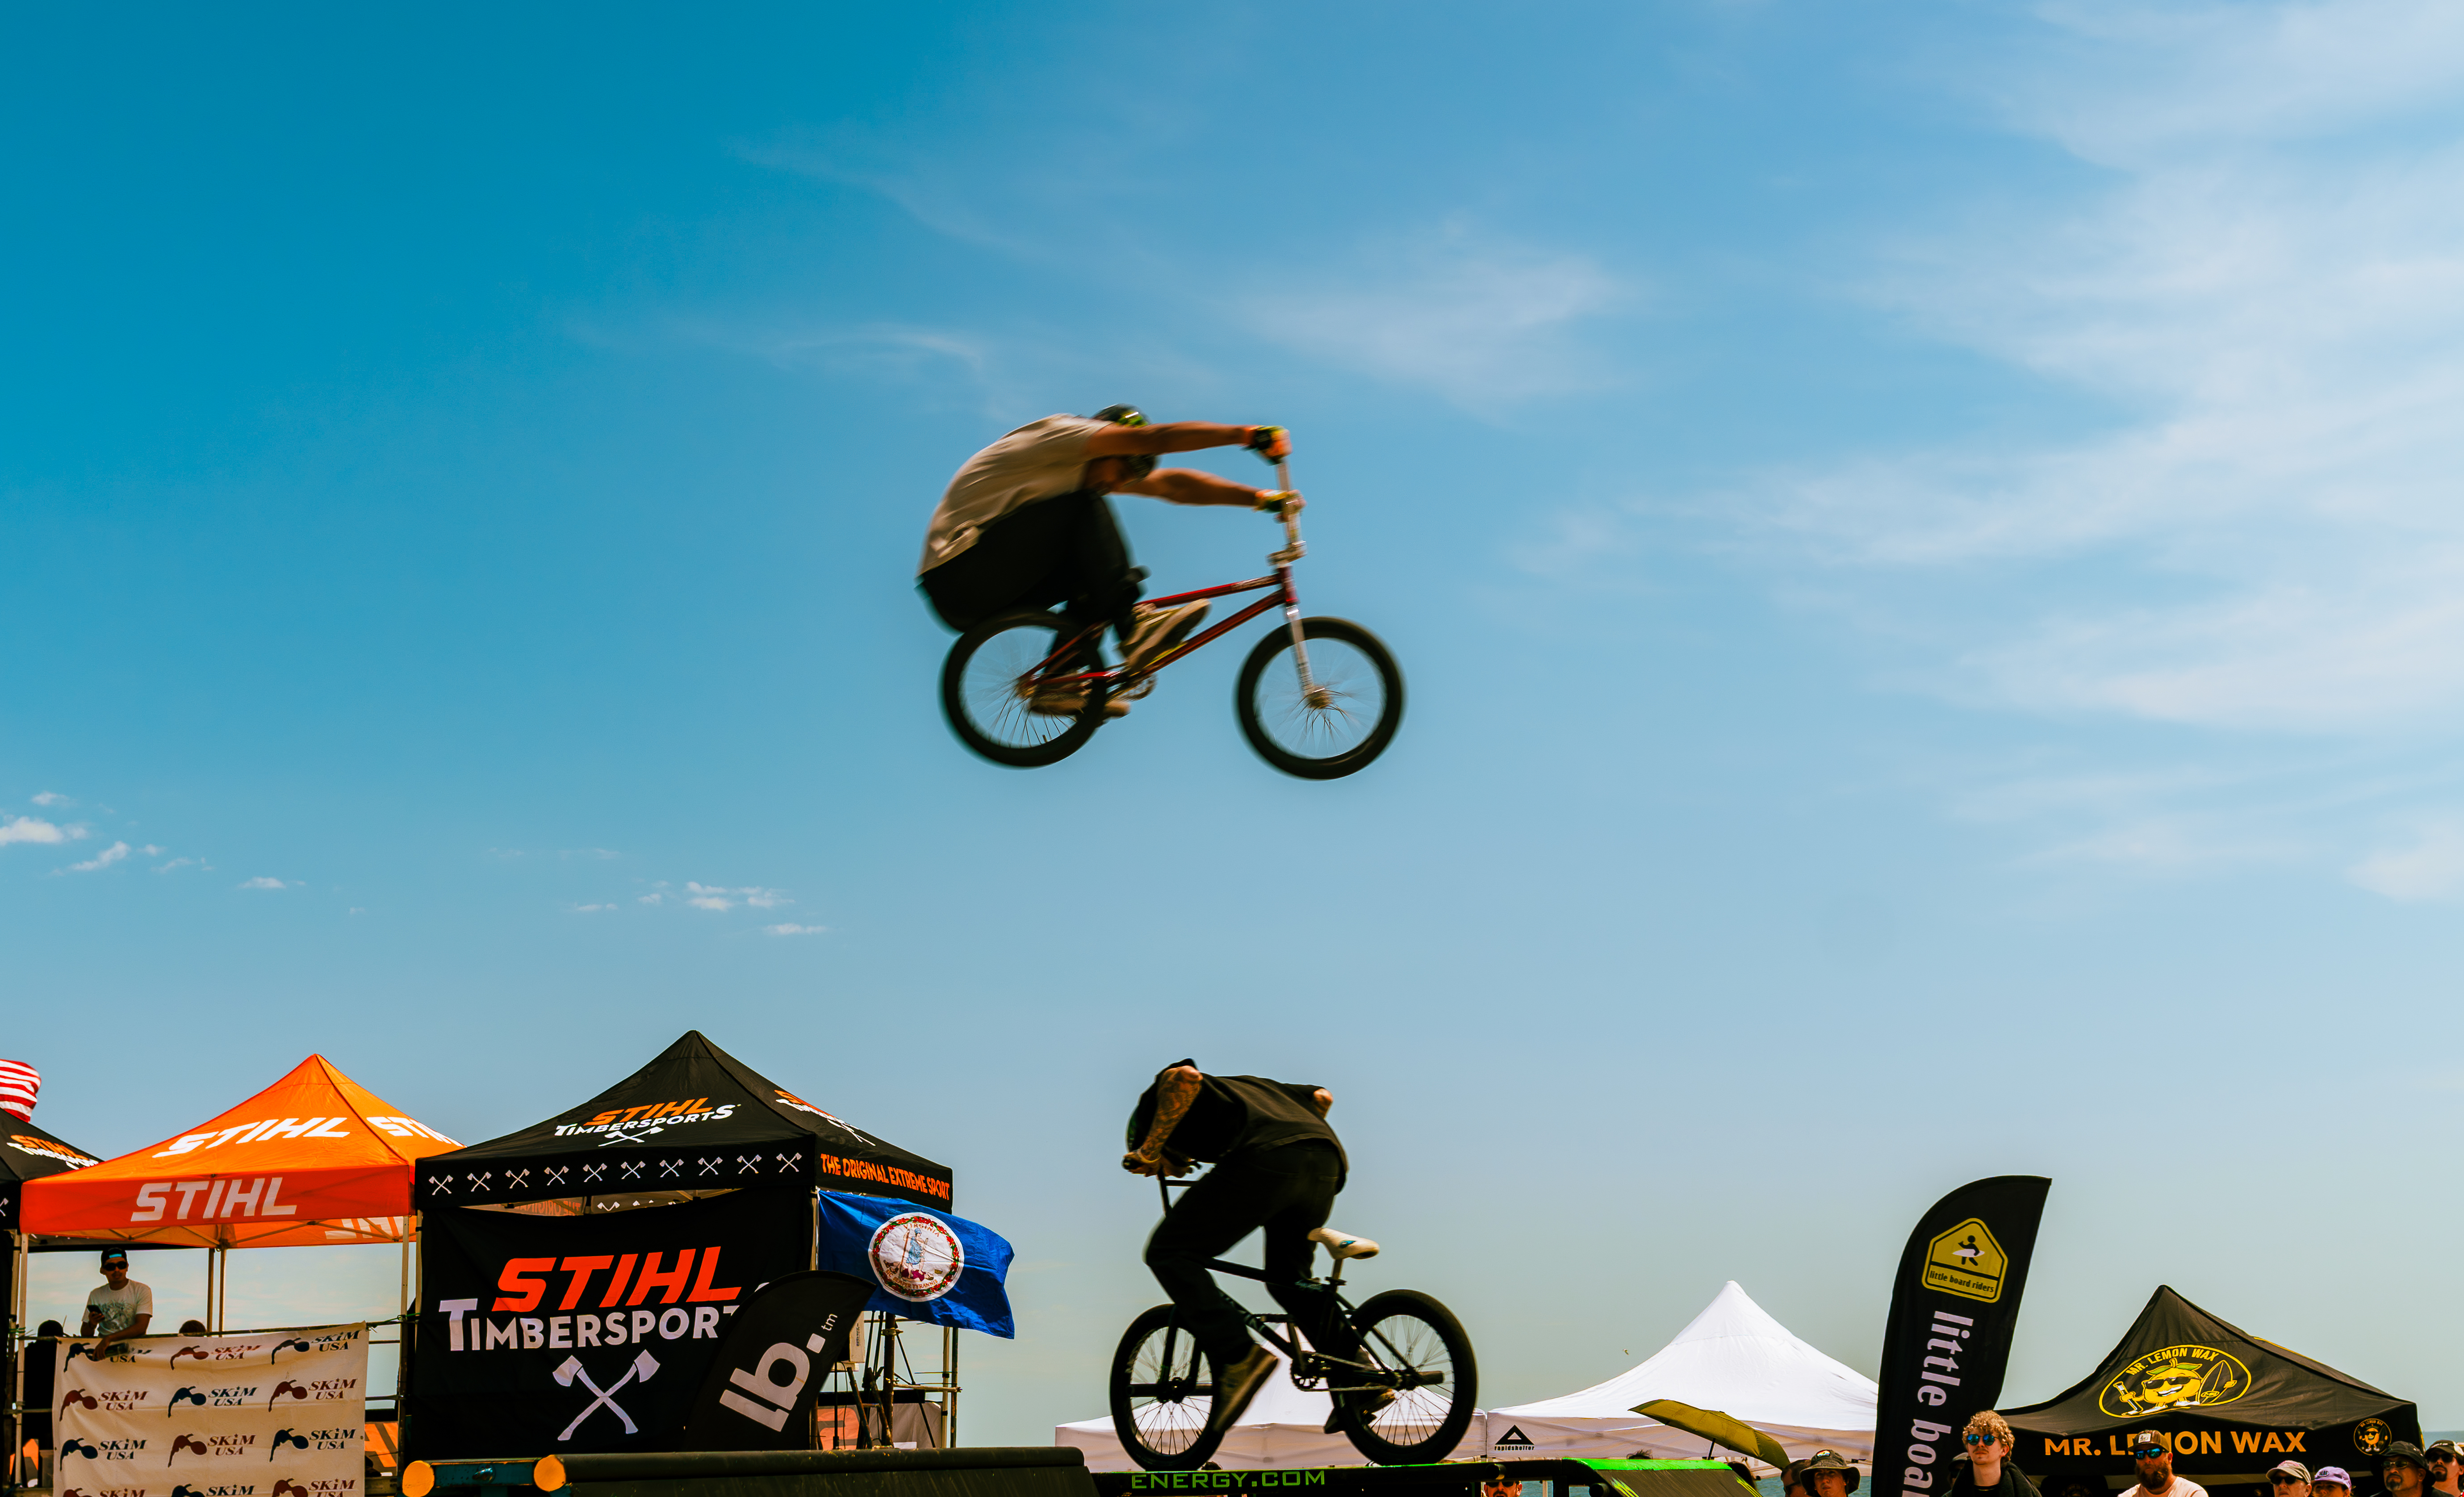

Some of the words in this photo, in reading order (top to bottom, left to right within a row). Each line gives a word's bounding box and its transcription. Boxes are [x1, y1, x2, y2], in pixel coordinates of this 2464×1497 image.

[554, 1104, 736, 1136] TIMBERSPORTS
[583, 1097, 713, 1126] STIHL
[11, 1135, 88, 1160] STIHL
[152, 1117, 351, 1158] STIHL
[820, 1153, 841, 1175] THE
[843, 1158, 889, 1183] ORIGINAL
[888, 1167, 928, 1193] EXTREME
[926, 1177, 950, 1200] SPORT
[130, 1177, 297, 1222] STIHL
[903, 1223, 941, 1238] VIRGINIA
[492, 1246, 742, 1313] STIHL
[885, 1269, 893, 1277] SIC
[893, 1276, 911, 1288] SEMPER
[912, 1279, 938, 1289] TYRANNIS
[1929, 1271, 1948, 1281] little
[1949, 1275, 1971, 1287] board
[1972, 1282, 1994, 1292] riders
[439, 1282, 770, 1351] TIMBERSPOR
[821, 1314, 837, 1331] tm
[319, 1342, 349, 1352] USA
[110, 1354, 136, 1363] USA
[1917, 1311, 1974, 1406] little
[2125, 1363, 2148, 1376] MR.
[2147, 1348, 2188, 1364] LEMON
[2192, 1348, 2219, 1361] WAX
[214, 1398, 243, 1406] USA
[315, 1391, 343, 1400] USA
[105, 1402, 134, 1411] USA
[215, 1447, 243, 1456] USA
[317, 1441, 344, 1450] USA
[2045, 1438, 2101, 1455] MR.
[2230, 1431, 2306, 1453] WAX
[106, 1451, 134, 1460] USA
[1132, 1471, 1325, 1489] ENERGY.COM
